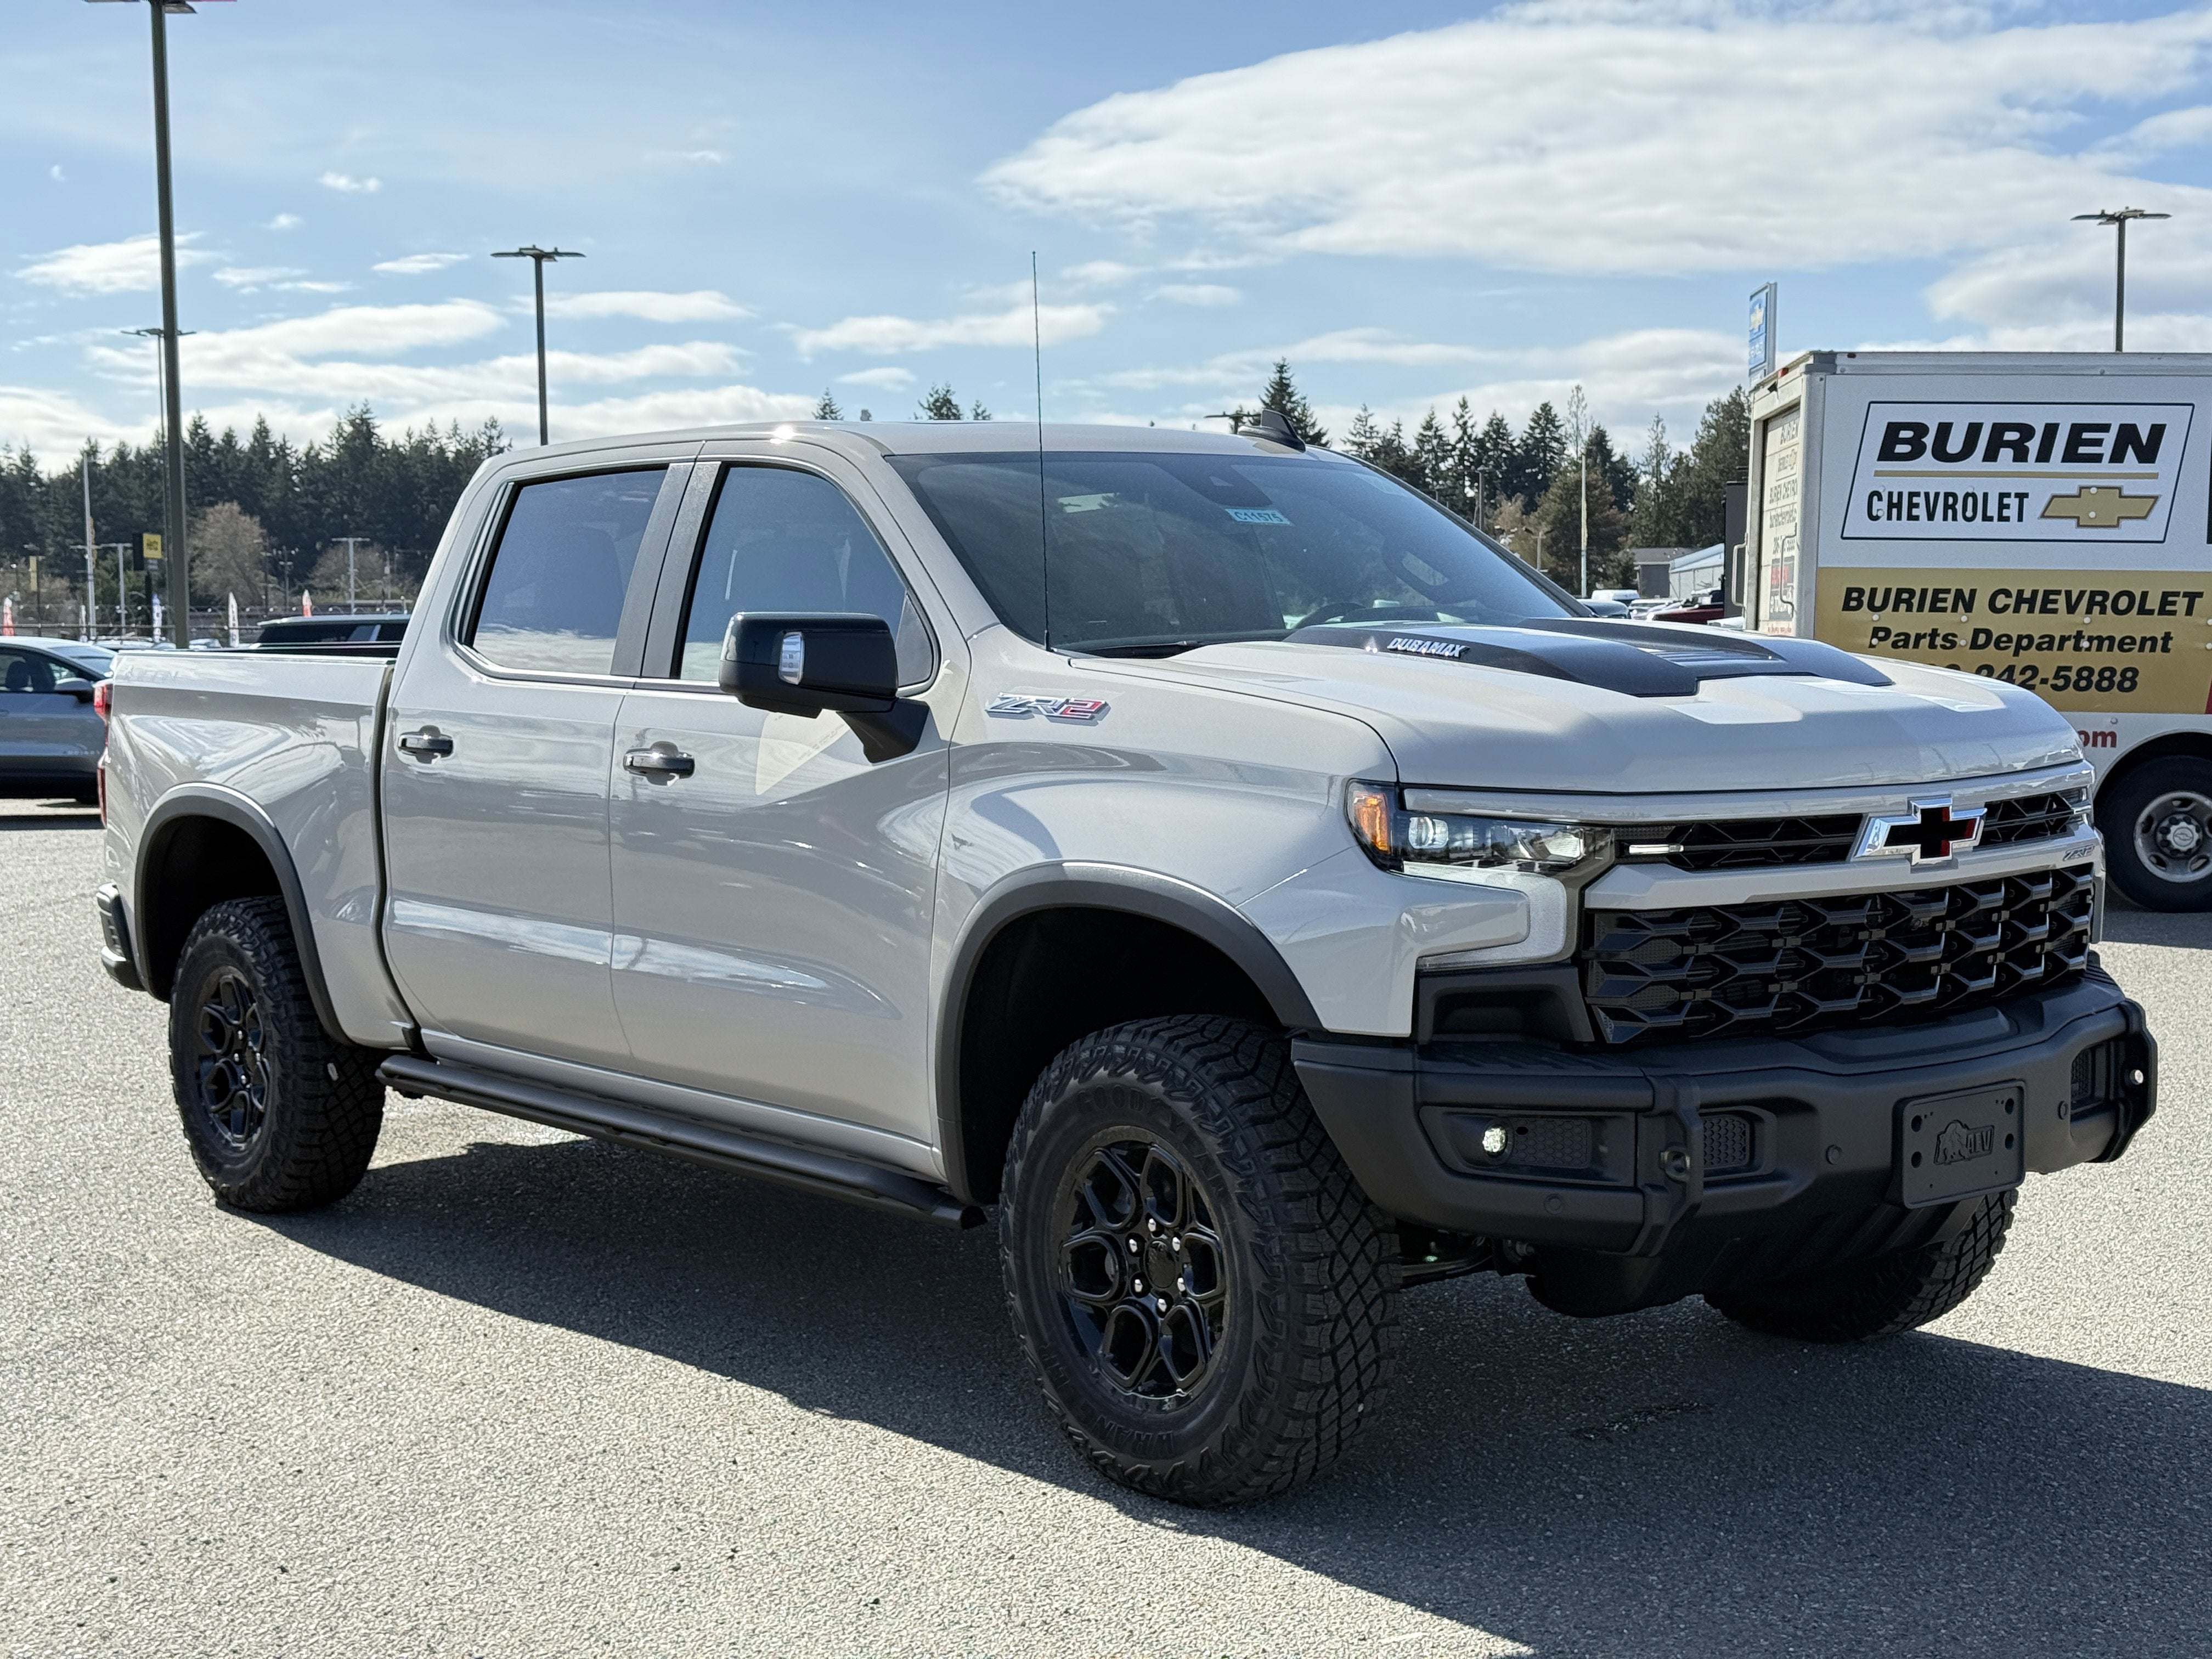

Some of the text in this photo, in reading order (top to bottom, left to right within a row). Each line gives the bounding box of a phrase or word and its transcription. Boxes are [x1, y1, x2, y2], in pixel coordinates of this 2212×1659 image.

[1876, 421, 2167, 464] BURIEN
[1234, 511, 1283, 522] C11575
[1867, 490, 2029, 523] CHEVROLET
[1842, 587, 2204, 617] BURIEN CHEVROLET
[1386, 637, 1469, 657] DURAMAX
[1868, 627, 2173, 657] Parts Department
[984, 692, 1107, 720] ZR2
